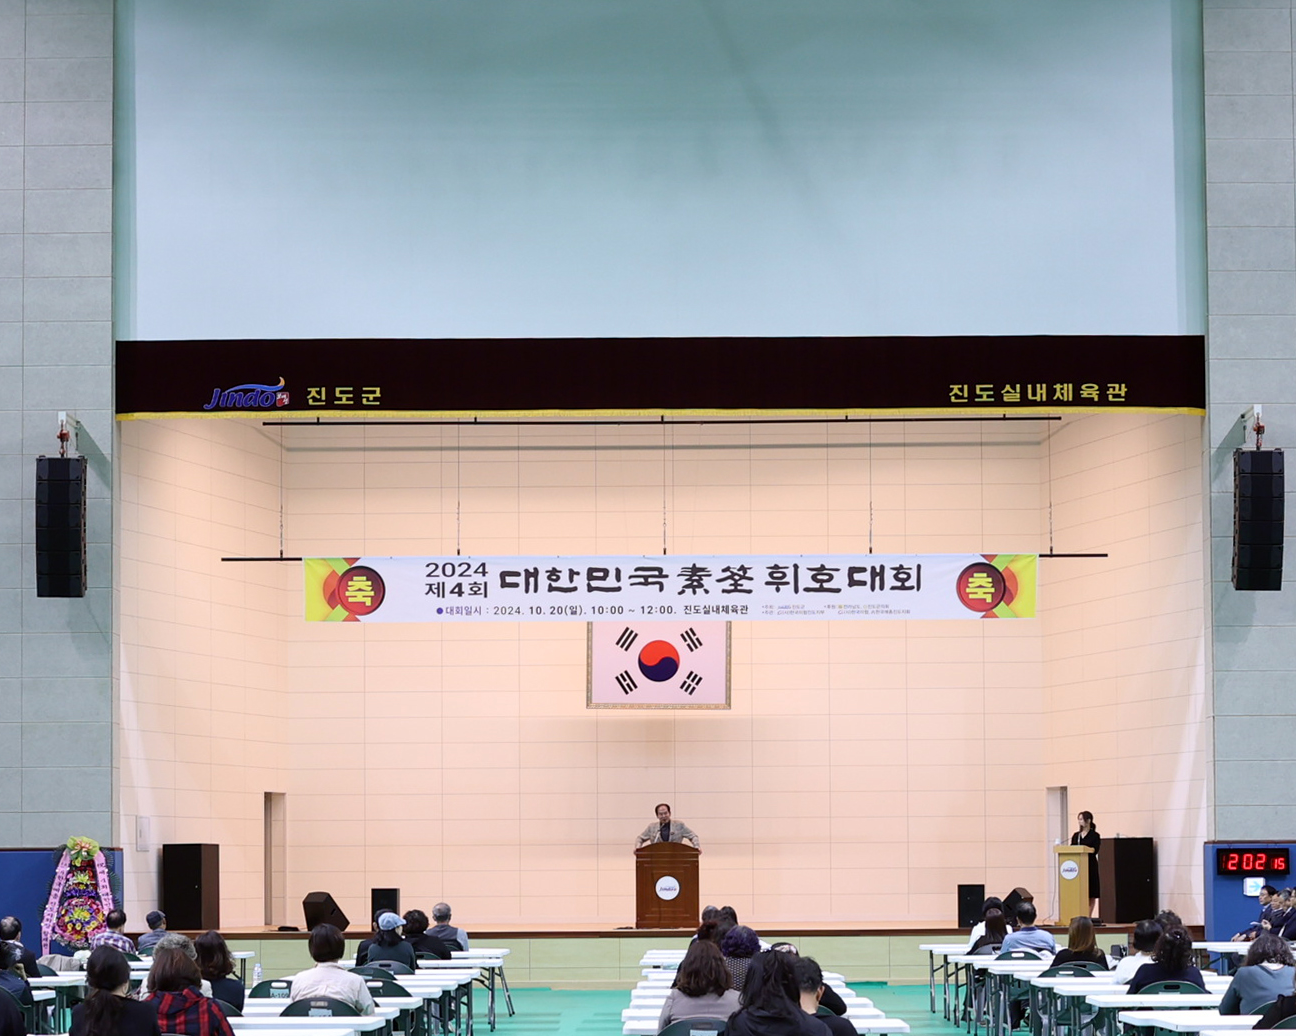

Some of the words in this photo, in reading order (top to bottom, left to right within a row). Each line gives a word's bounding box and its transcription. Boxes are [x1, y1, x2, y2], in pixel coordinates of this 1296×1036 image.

[203, 388, 275, 410] Jindo
[306, 386, 381, 405] 진도군
[948, 383, 1128, 403] 진도실내체육관
[425, 562, 489, 578] 2024
[499, 566, 669, 594] 대한민국
[764, 563, 922, 596] 휘호대회
[345, 576, 375, 606] 축
[425, 581, 489, 599] 제4회
[965, 572, 995, 603] 축
[445, 605, 482, 616] 대회일시
[493, 605, 525, 616] 2024.
[529, 605, 546, 616] 10.
[591, 605, 624, 616] 10:00
[640, 605, 677, 616] 12:00.
[683, 604, 749, 616] 진도실내체육관
